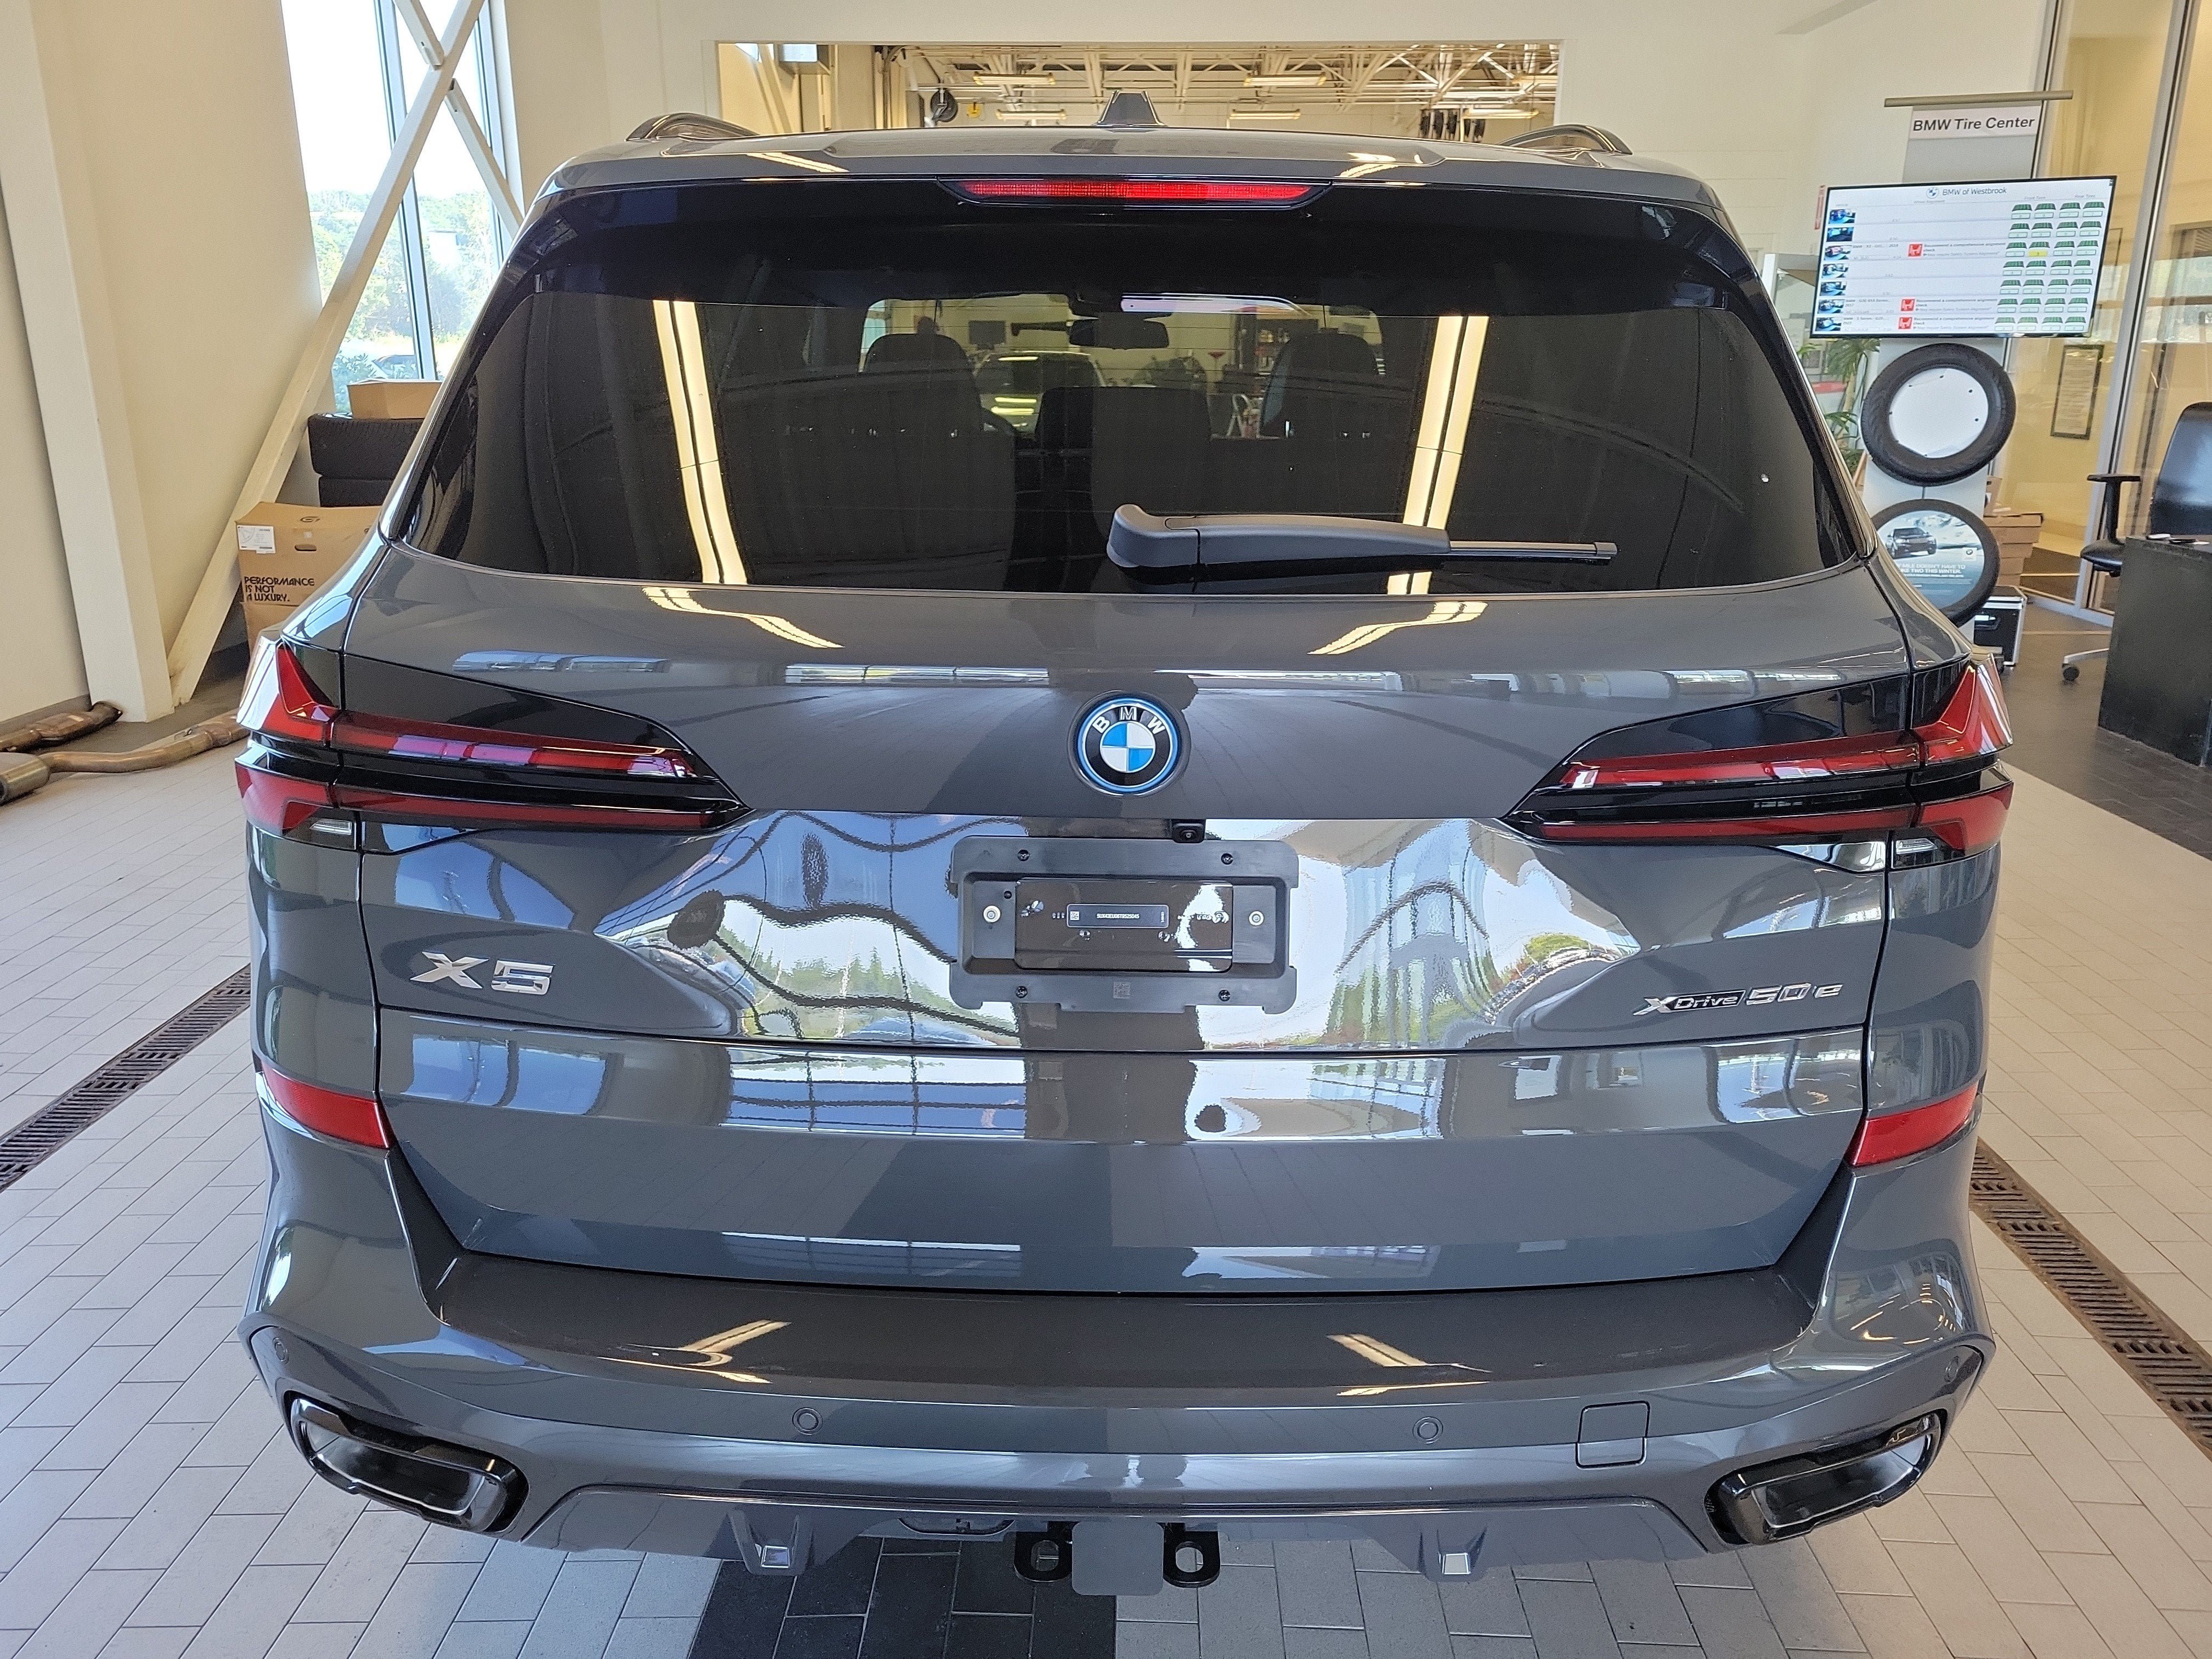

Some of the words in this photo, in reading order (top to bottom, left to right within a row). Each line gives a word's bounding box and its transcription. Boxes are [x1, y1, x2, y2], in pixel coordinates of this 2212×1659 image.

[1913, 119, 1951, 131] BMW
[1954, 119, 1982, 129] Tire
[1985, 117, 2035, 128] Center
[245, 577, 314, 586] PERFORMANCE
[255, 585, 275, 593] NOT
[255, 594, 290, 602] LUXURY.
[1092, 706, 1166, 734] BMW
[410, 950, 555, 995] X5
